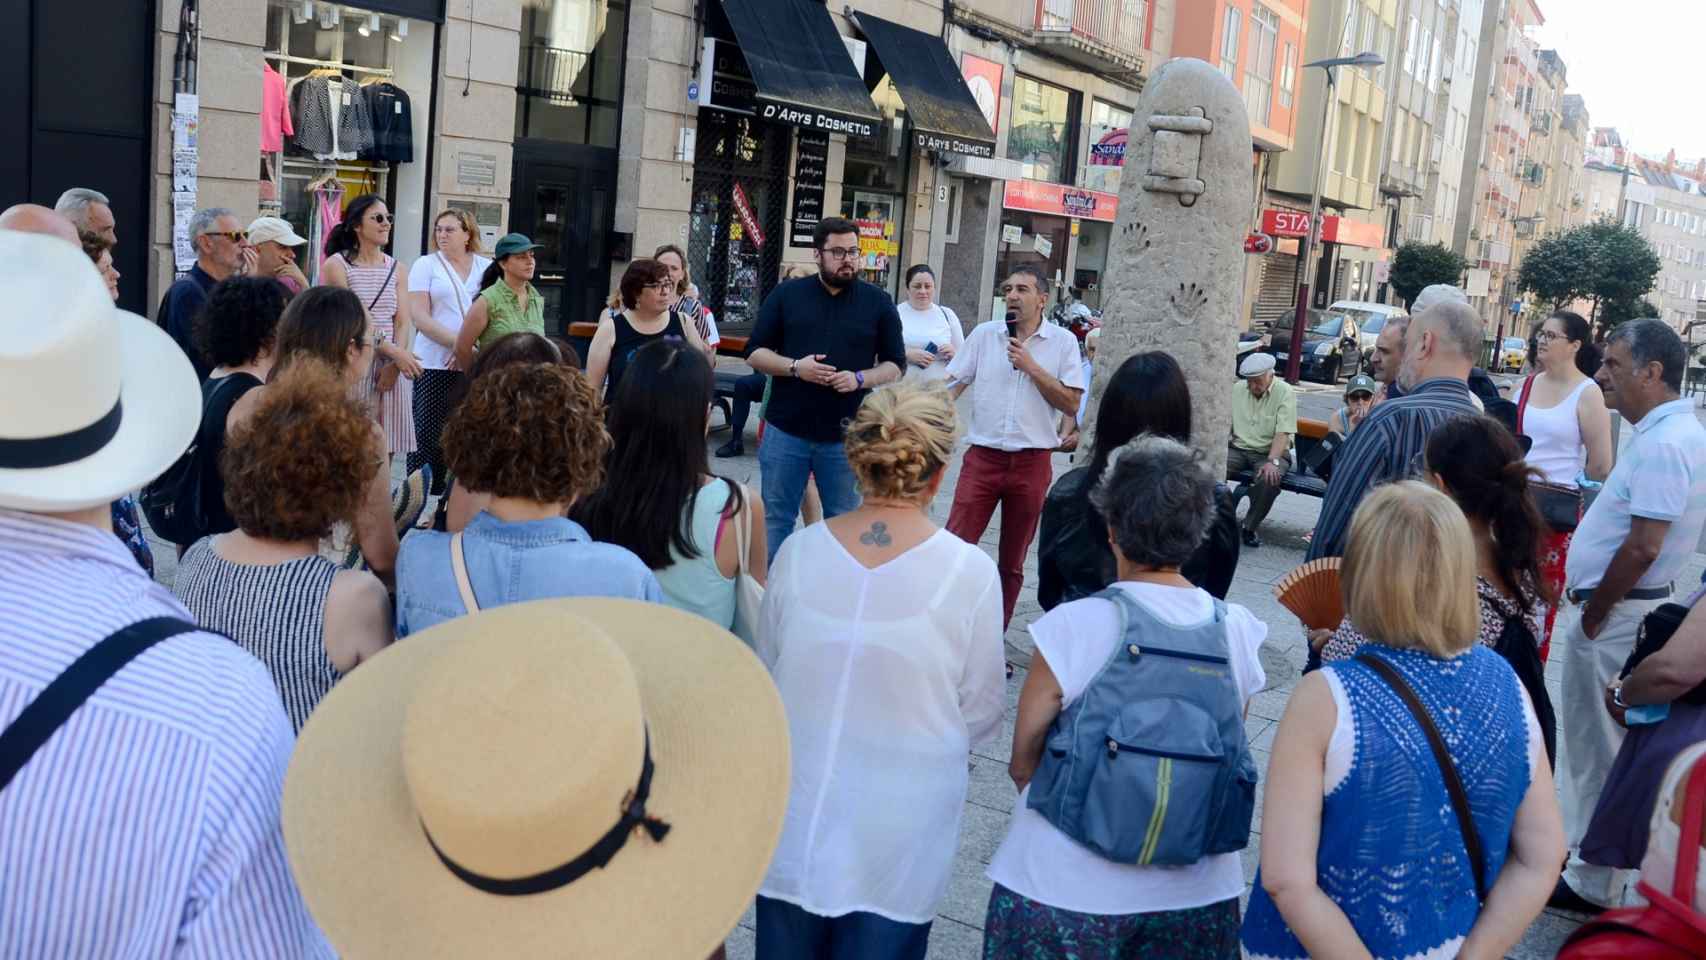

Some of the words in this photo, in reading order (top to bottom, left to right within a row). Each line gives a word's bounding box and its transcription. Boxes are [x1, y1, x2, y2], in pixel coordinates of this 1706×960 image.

[763, 105, 812, 125] D'ARYS
[816, 114, 871, 136] COSMETIC
[918, 134, 950, 151] D'ARYS
[952, 140, 991, 157] COSMETIC
[940, 186, 946, 201] 3
